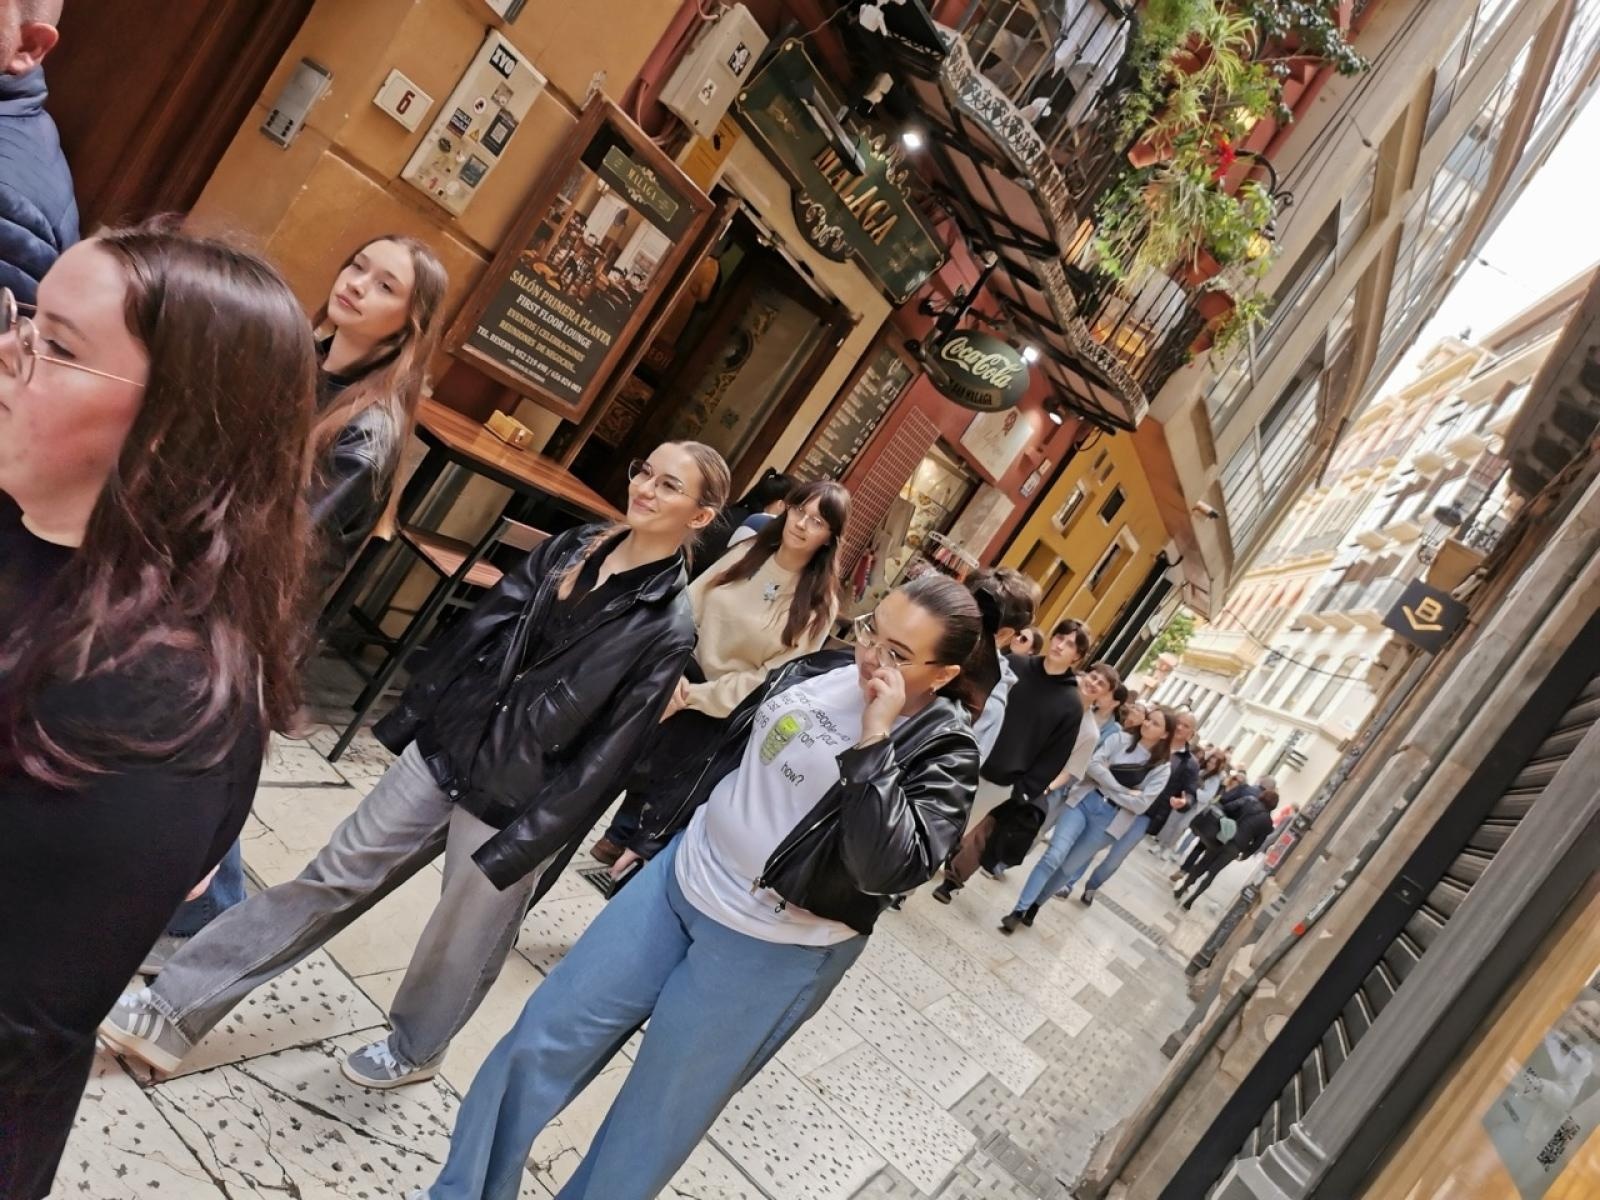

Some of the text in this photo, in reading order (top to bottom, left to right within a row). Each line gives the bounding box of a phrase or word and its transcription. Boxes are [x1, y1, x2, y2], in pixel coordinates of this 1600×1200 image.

[396, 89, 415, 115] 6
[510, 270, 611, 346] SALÓN PRIMERA PLANTA
[516, 294, 592, 349] FIRST FLOOR LOUNGE
[489, 333, 515, 353] RESERVA
[499, 319, 537, 347] REUNIONES
[535, 342, 547, 353] DE
[506, 307, 537, 331] EVENTOS
[538, 325, 586, 362] CELEBRACIONES
[781, 761, 805, 787] how?
